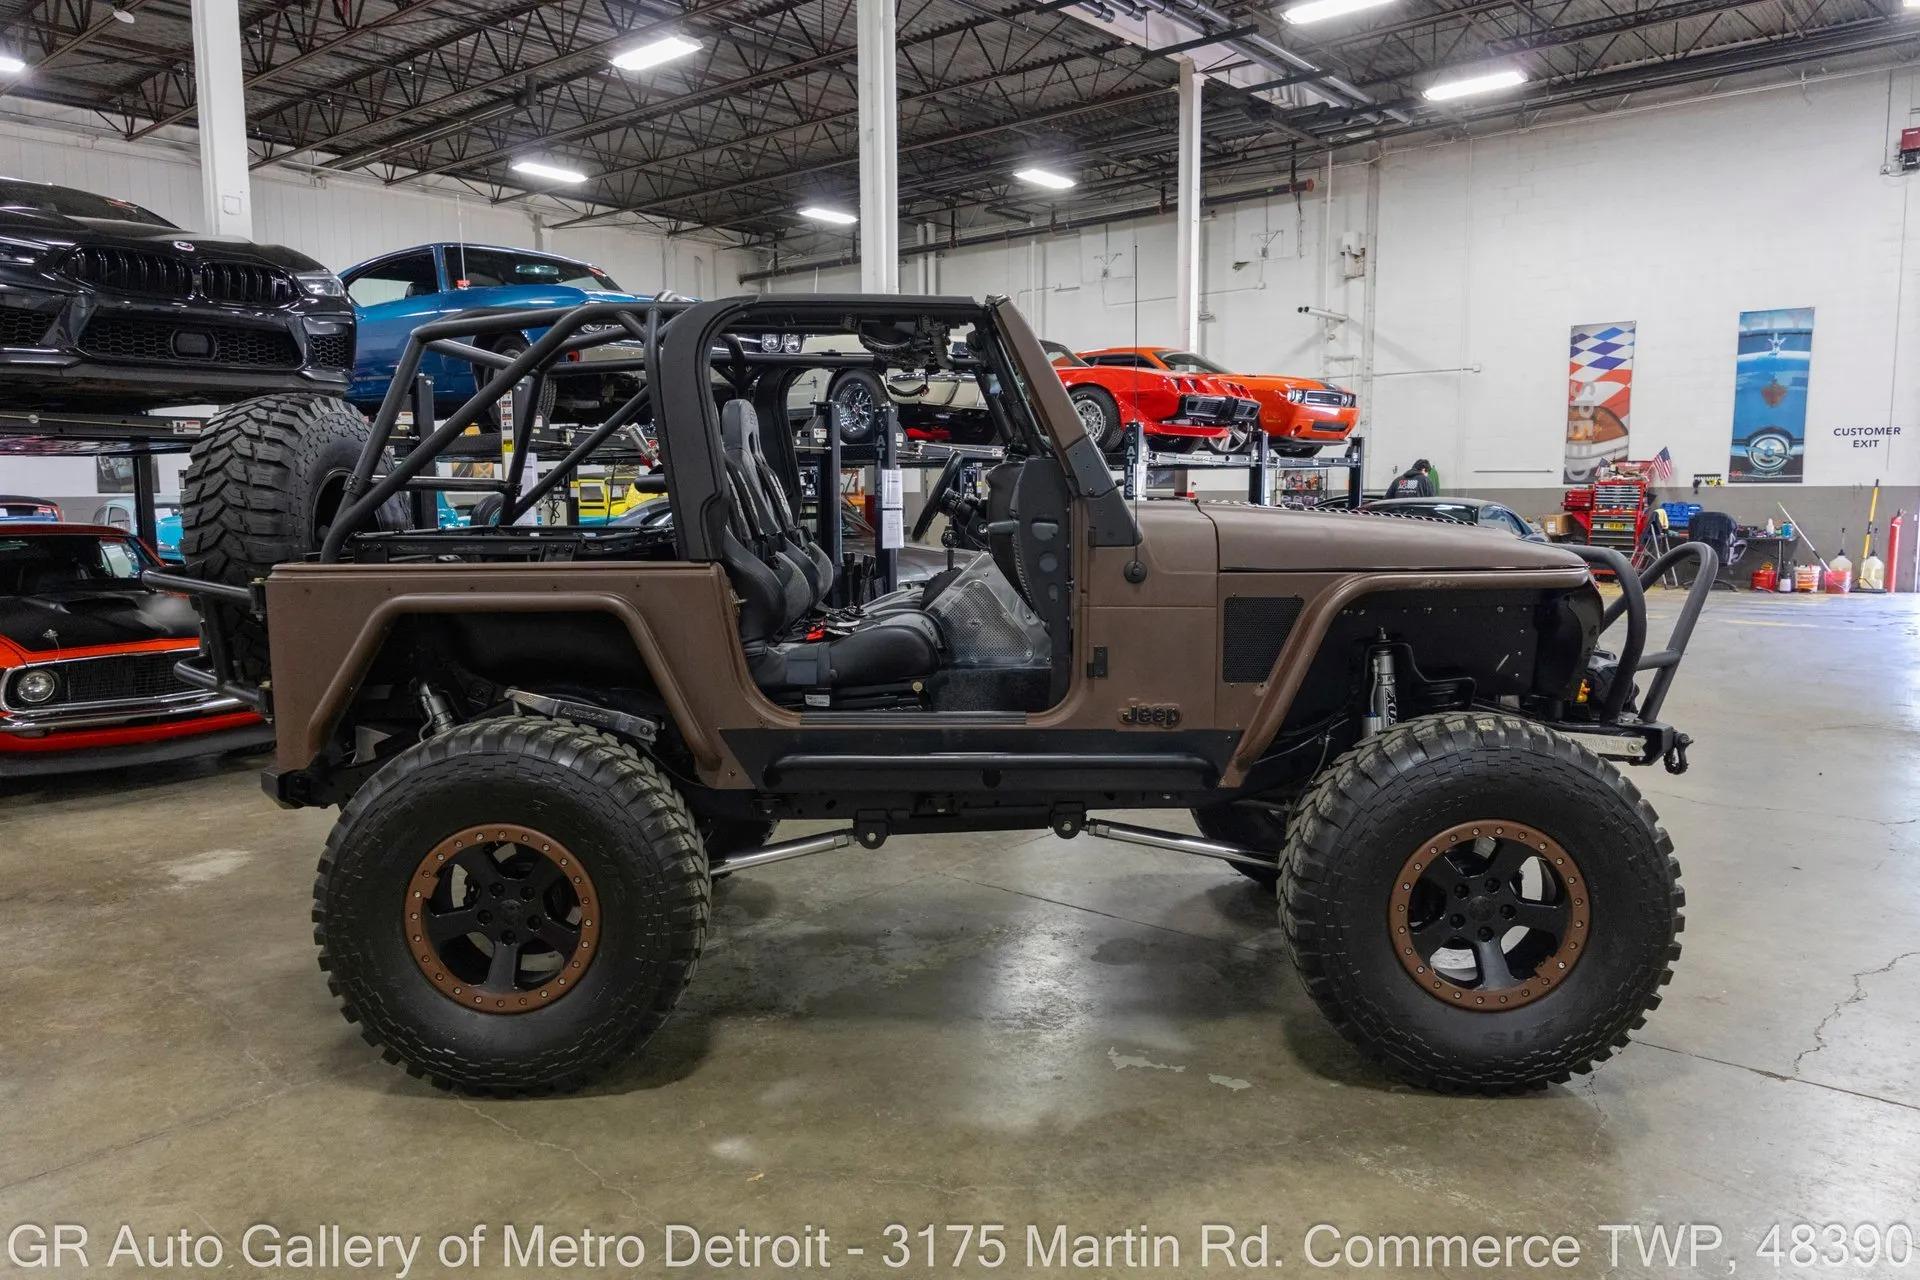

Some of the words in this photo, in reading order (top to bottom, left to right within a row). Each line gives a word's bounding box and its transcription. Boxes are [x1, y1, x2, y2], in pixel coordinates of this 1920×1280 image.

[1833, 427, 1901, 436] CUSTOMER
[1853, 440, 1879, 448] EXIT
[1126, 446, 1135, 496] ATLAS
[1121, 705, 1179, 728] Jeep
